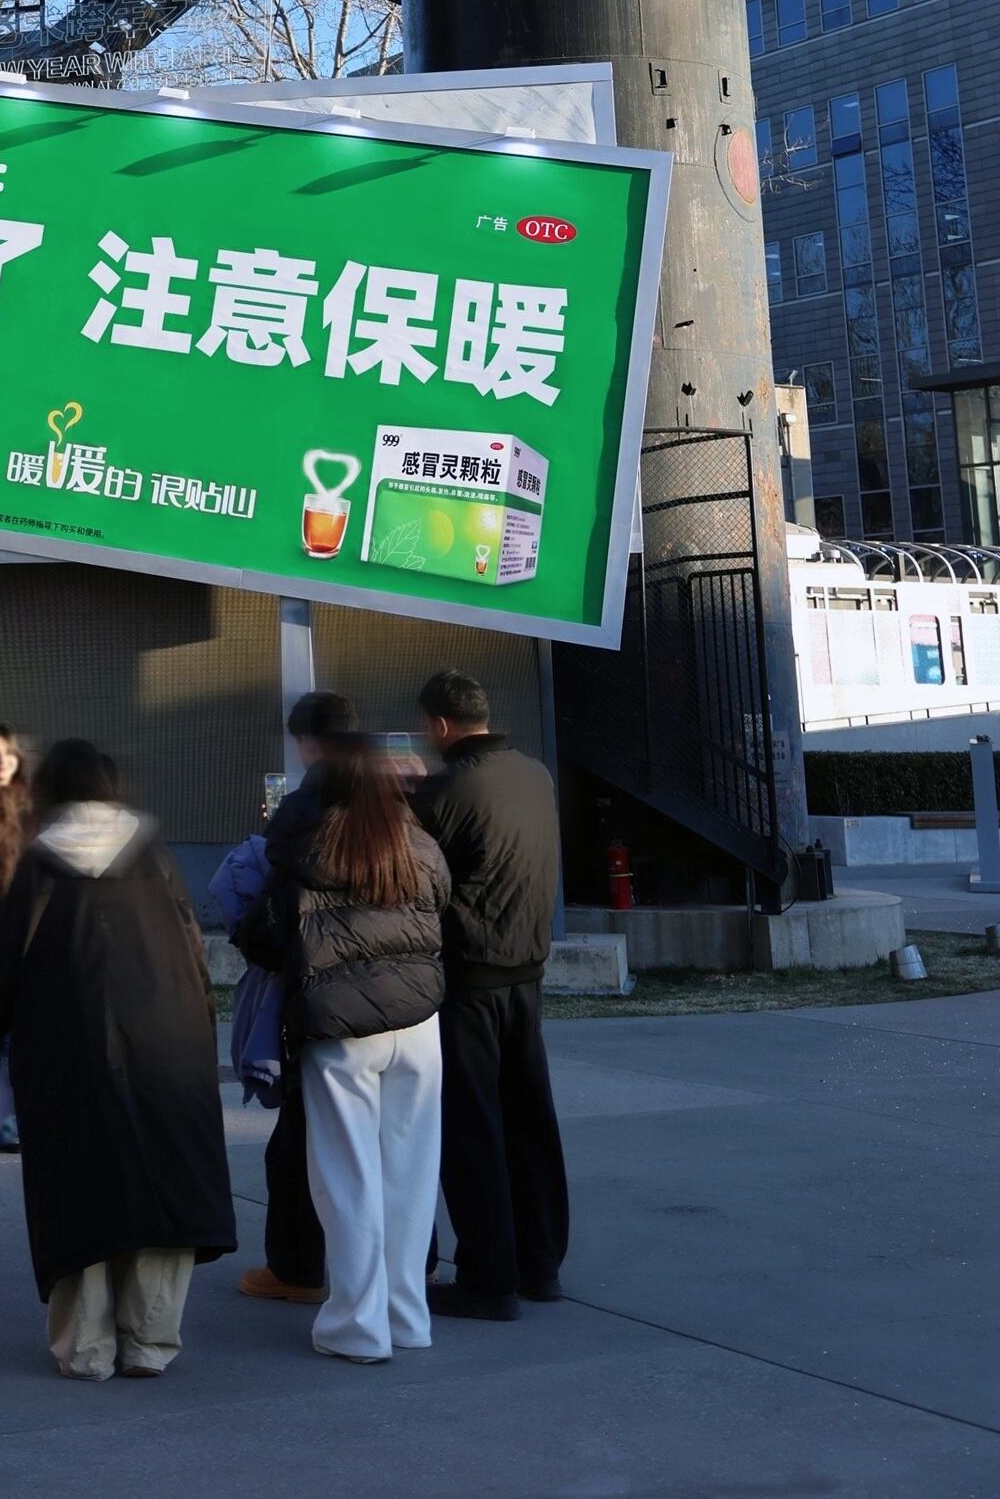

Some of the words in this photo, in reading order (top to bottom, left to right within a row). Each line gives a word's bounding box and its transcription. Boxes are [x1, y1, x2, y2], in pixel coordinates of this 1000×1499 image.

[27, 53, 101, 80] YEAR
[475, 215, 508, 232] 广告
[525, 220, 569, 240] OTC
[80, 230, 569, 406] 注意保暖
[382, 434, 400, 446] 999
[6, 441, 143, 501] 暖暖的
[151, 473, 257, 519] 很贴心
[401, 451, 502, 485] 感冒灵颗粒
